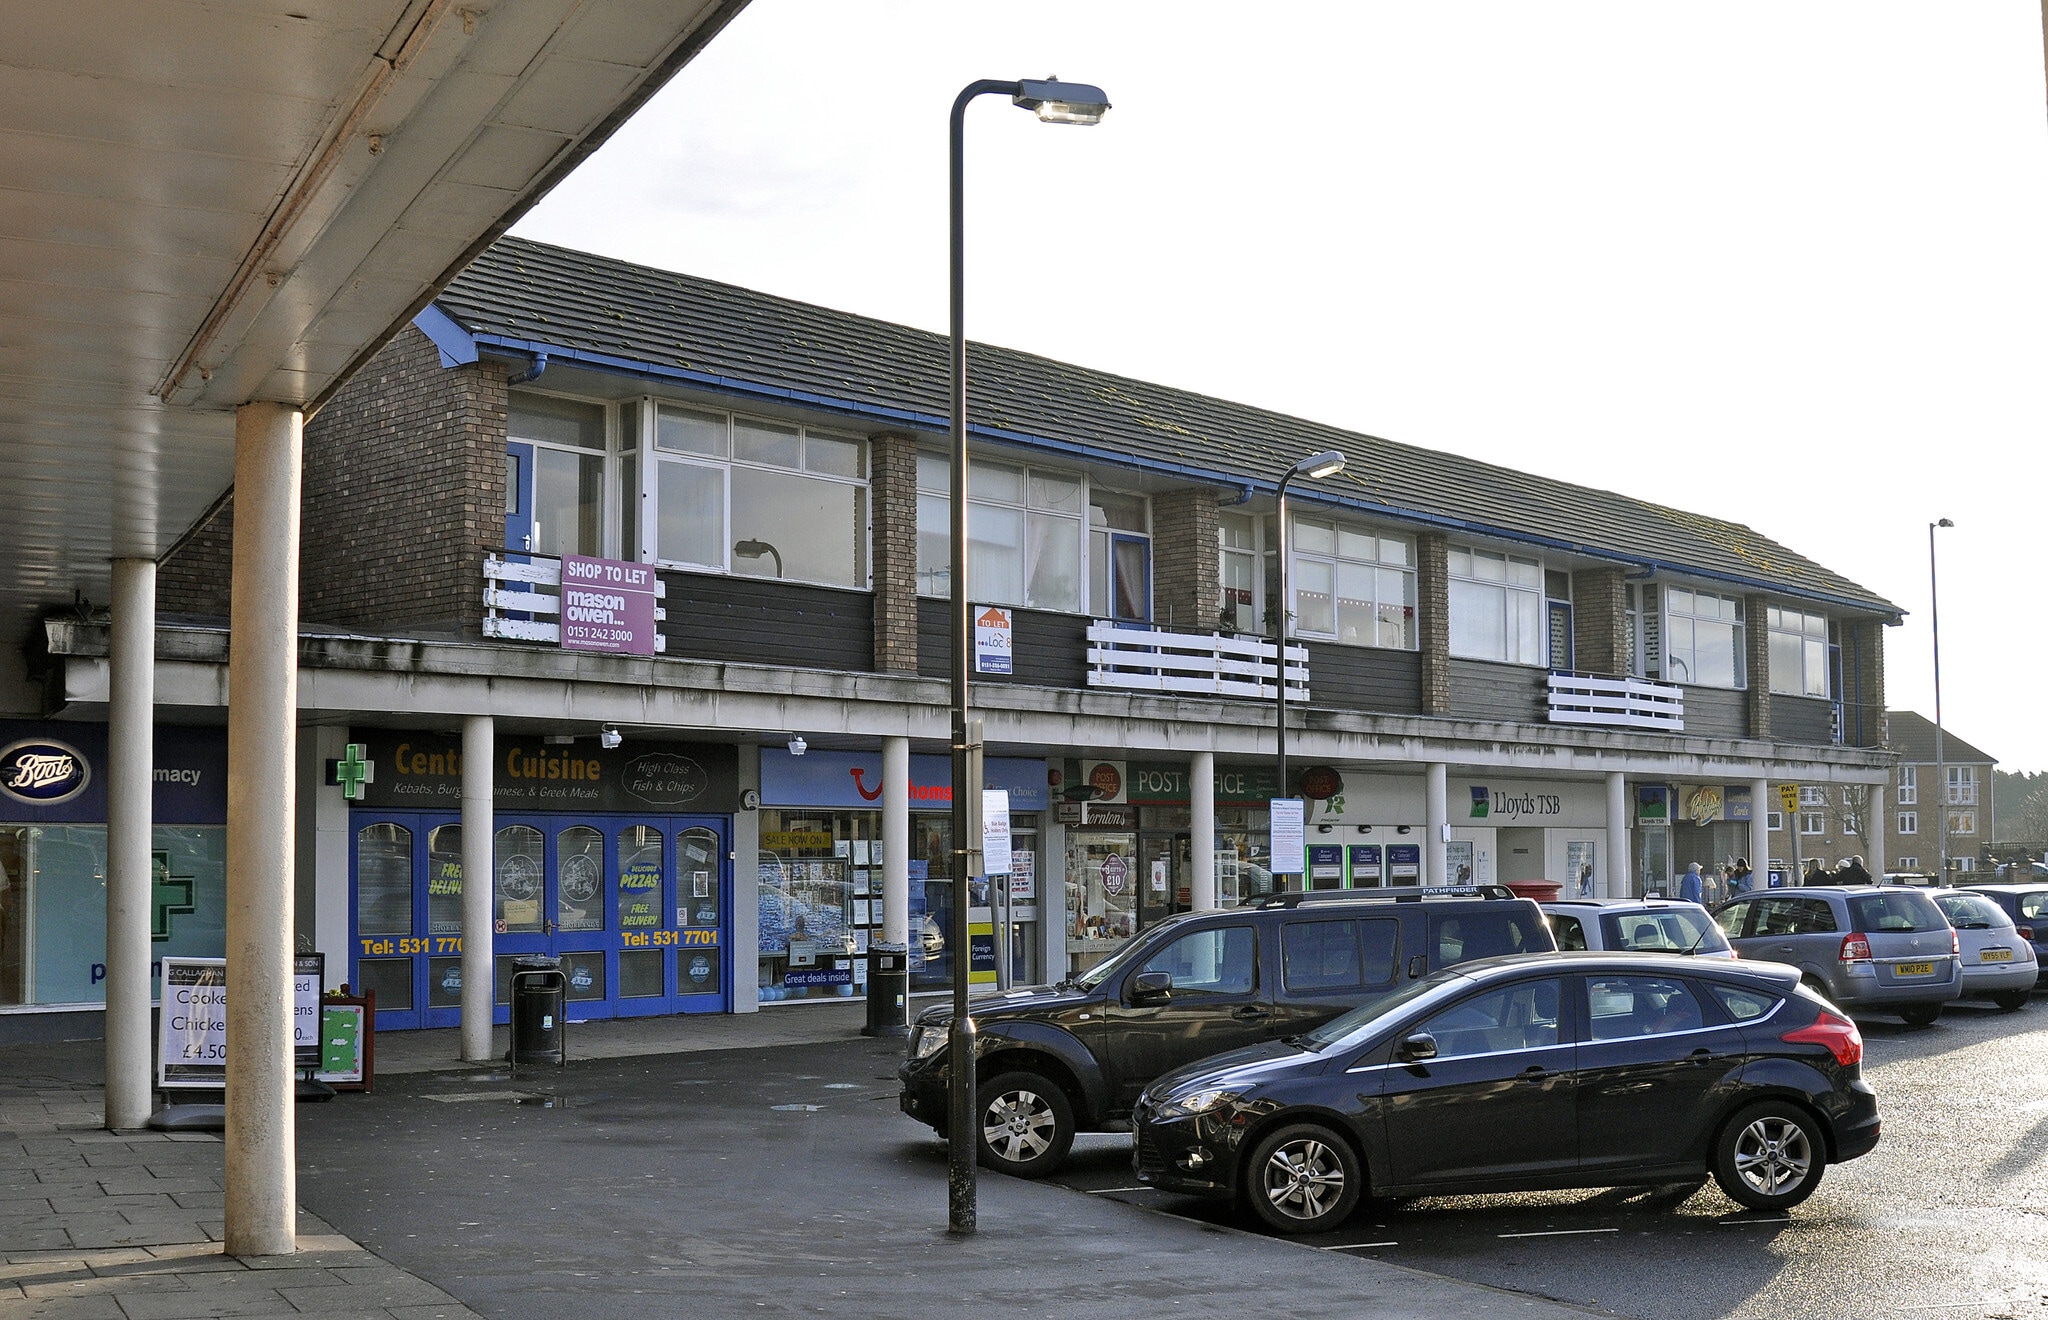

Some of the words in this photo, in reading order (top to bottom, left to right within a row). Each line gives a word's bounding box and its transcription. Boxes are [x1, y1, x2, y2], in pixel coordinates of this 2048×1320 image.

[568, 561, 602, 579] SHOP
[605, 565, 622, 582] TO
[625, 568, 647, 585] LET
[567, 590, 625, 611] mason
[981, 619, 991, 627] TO
[993, 620, 1005, 628] LET
[567, 626, 589, 638] 0151
[591, 628, 608, 640] 242
[610, 629, 633, 642] 3000
[507, 747, 601, 781] Cuisine
[637, 761, 660, 778] High
[663, 762, 690, 774] Class
[8, 754, 74, 788] Boots
[1096, 773, 1115, 782] POST
[1139, 771, 1182, 793] POST
[1309, 775, 1329, 784] POST
[393, 782, 434, 796] Kebabs,
[528, 786, 536, 797] &
[539, 786, 568, 799] Greek
[570, 787, 600, 799] Meals
[632, 779, 653, 791] Fish
[655, 780, 663, 791] &
[667, 780, 695, 795] Chips
[1013, 786, 1038, 798] Choice
[1306, 784, 1332, 793] OFFICE
[1781, 785, 1796, 793] PAY
[1494, 791, 1535, 820] Lloyds
[1537, 794, 1561, 815] TSB
[1734, 805, 1748, 817] Cards
[765, 835, 786, 845] SALE
[788, 835, 810, 845] NOW
[810, 834, 822, 845] ON
[631, 865, 657, 873] DELICIOUS
[620, 874, 659, 888] PIZZAS
[1106, 875, 1121, 886] £10
[1770, 872, 1779, 886] P
[631, 904, 650, 914] FREE
[623, 915, 658, 926] DELIVERY
[621, 932, 649, 946] Tel:
[653, 931, 679, 945] 531
[684, 930, 718, 945] 7701
[361, 939, 394, 954] Tel:
[399, 938, 429, 954] 531
[972, 944, 991, 953] Foreign
[972, 953, 995, 961] Currency
[176, 969, 224, 977] CALLAGHAN
[1916, 964, 1929, 972] PZE
[784, 974, 806, 984] Great
[807, 973, 827, 983] deals
[828, 972, 850, 982] inside
[177, 990, 226, 1005] Cooke
